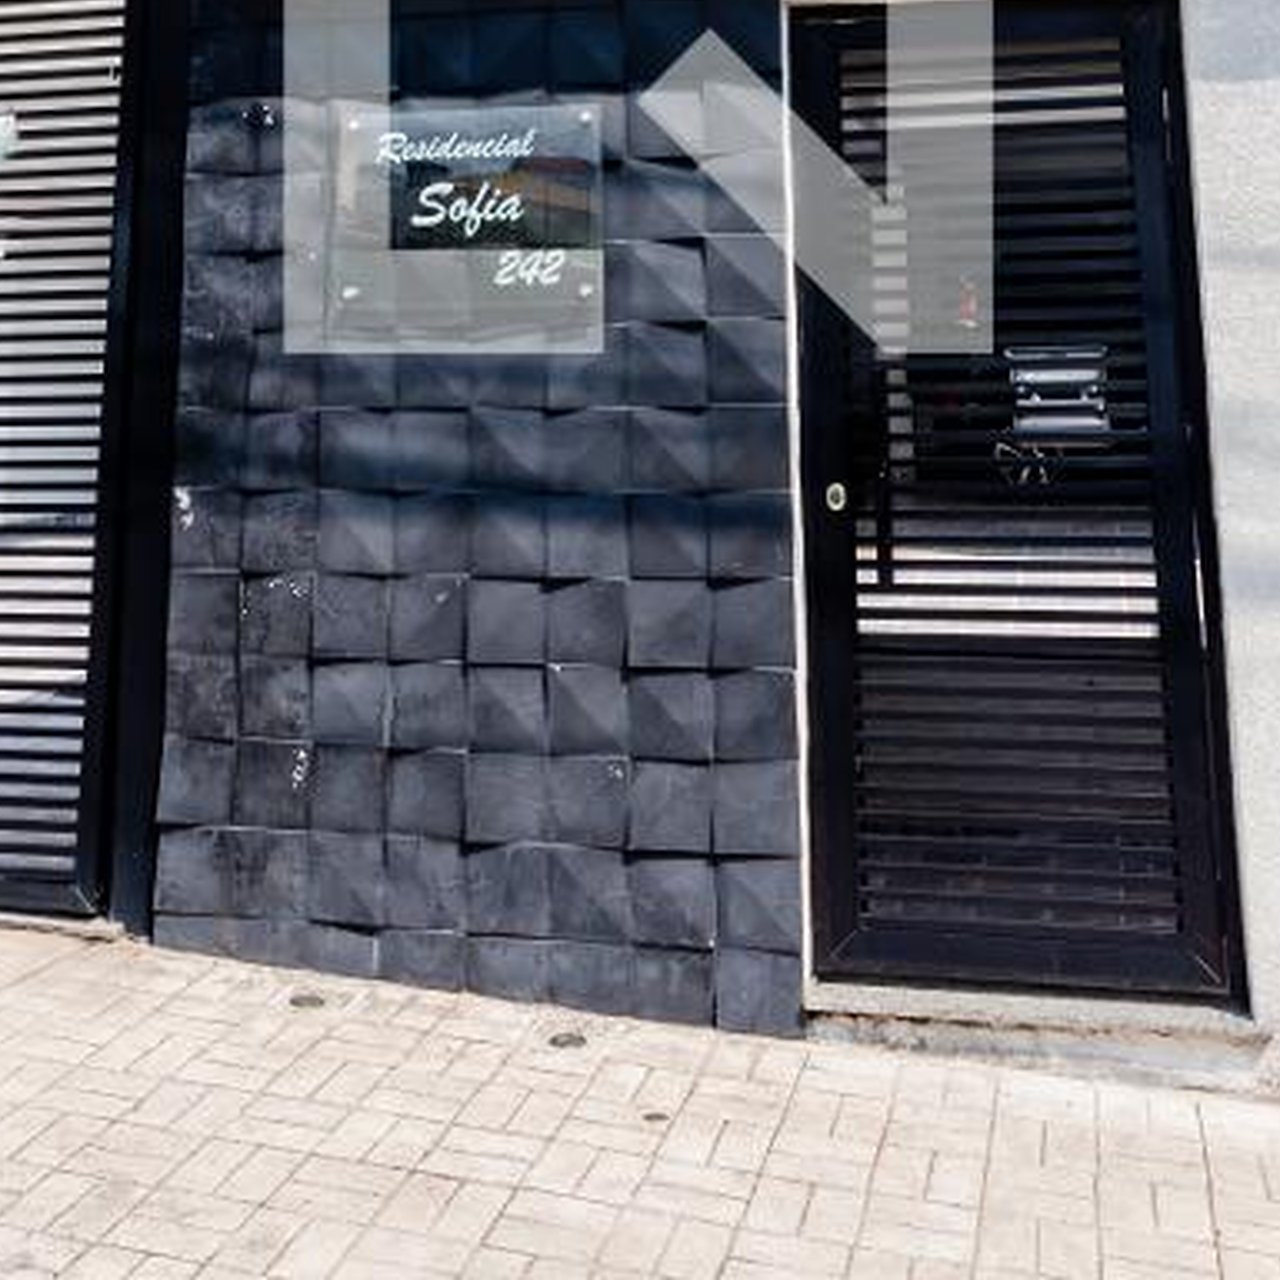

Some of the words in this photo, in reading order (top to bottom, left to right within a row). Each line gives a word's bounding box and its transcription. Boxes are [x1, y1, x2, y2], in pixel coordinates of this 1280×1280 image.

[376, 128, 537, 165] Residencial
[410, 181, 526, 238] Sofia
[493, 249, 566, 286] 242
